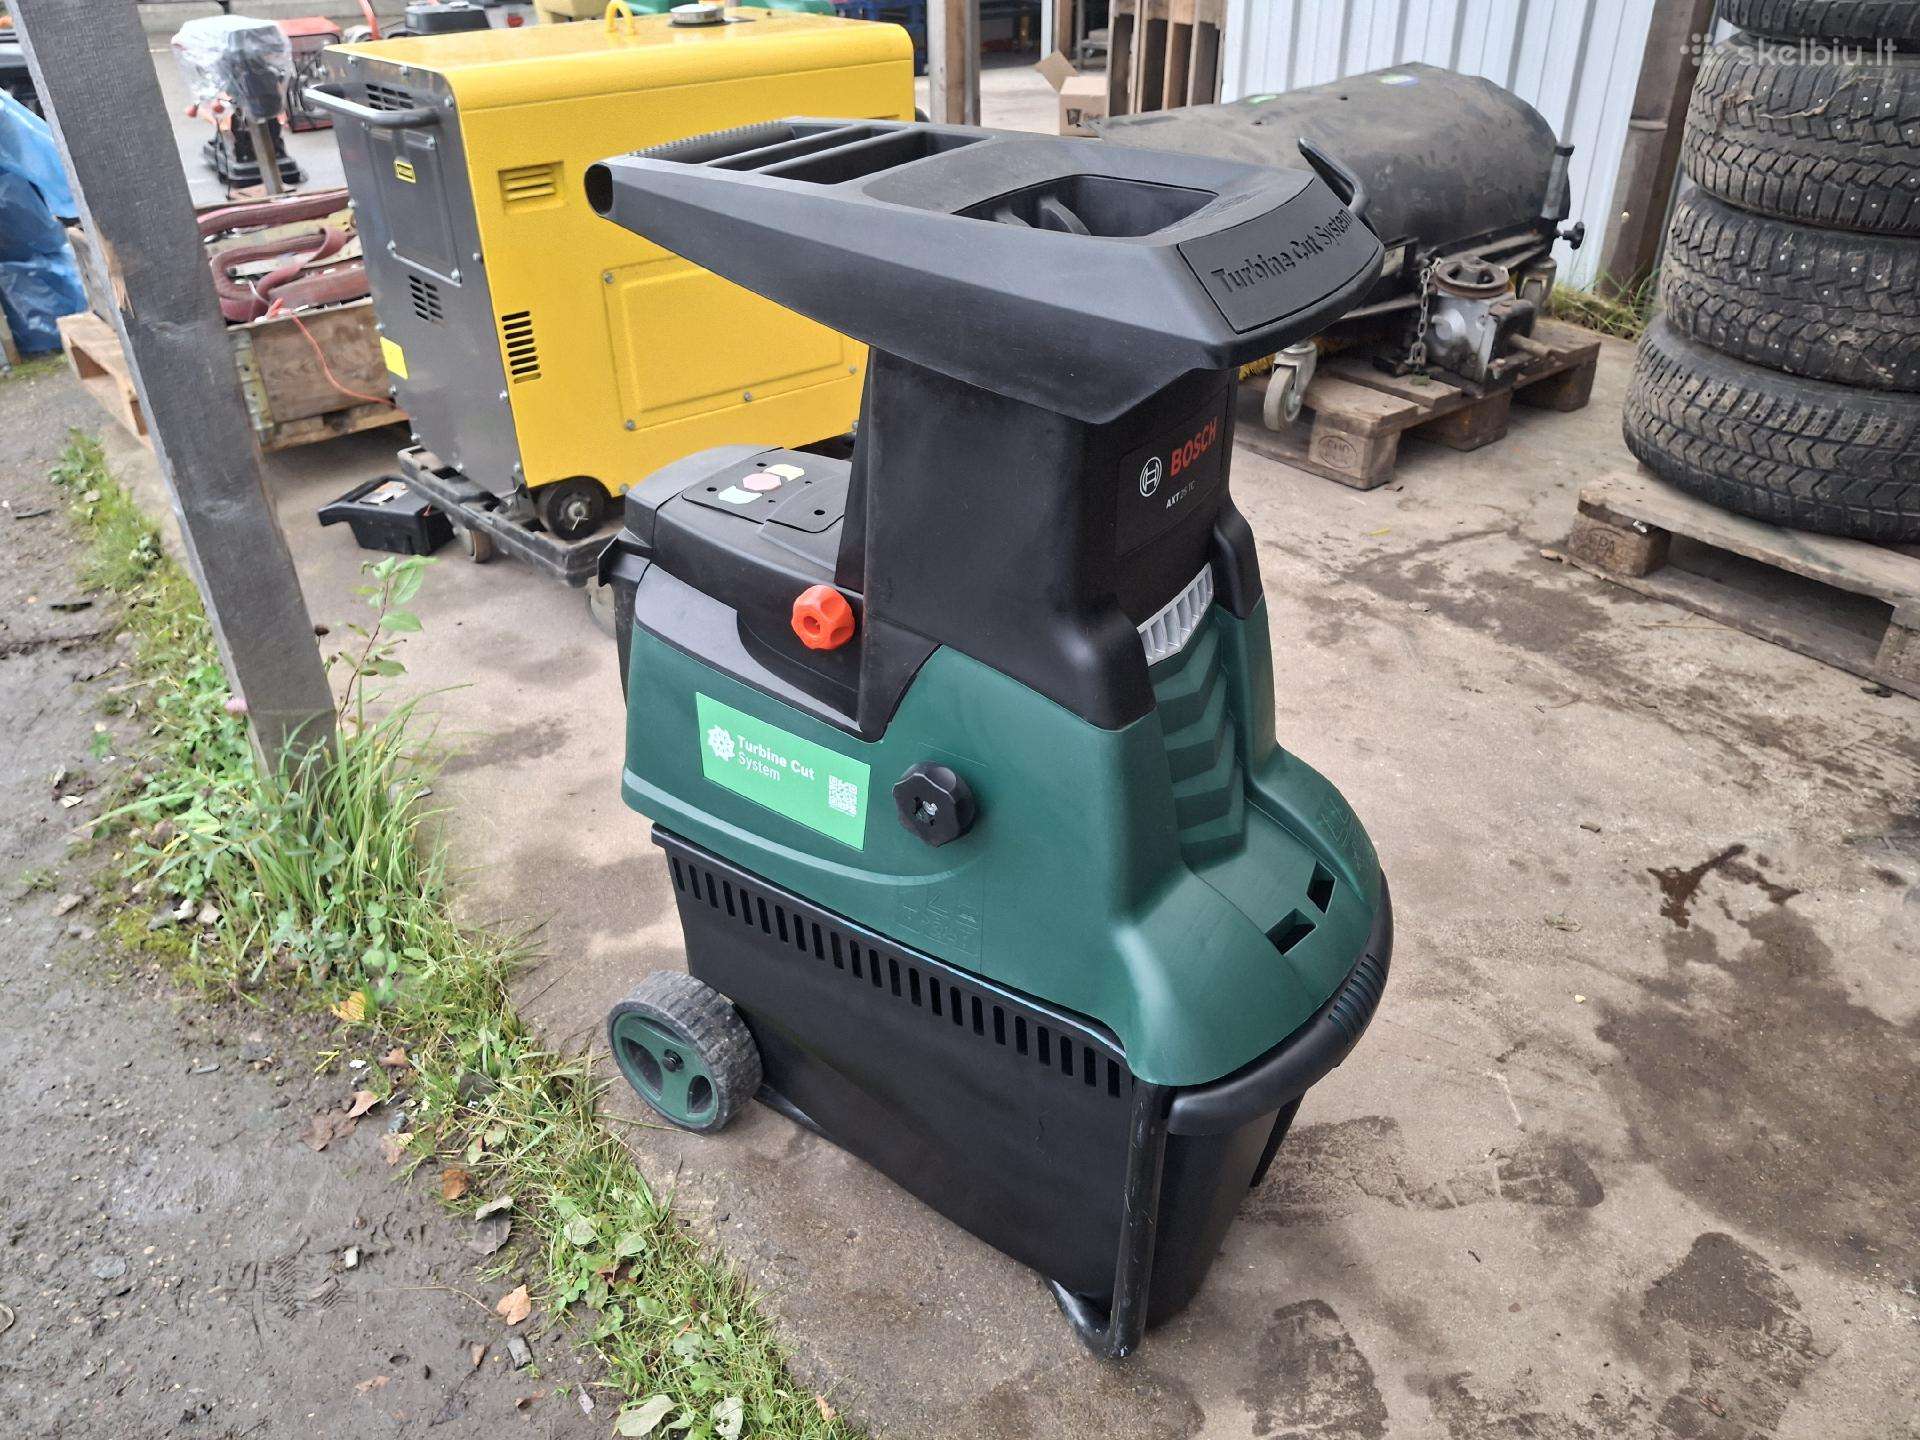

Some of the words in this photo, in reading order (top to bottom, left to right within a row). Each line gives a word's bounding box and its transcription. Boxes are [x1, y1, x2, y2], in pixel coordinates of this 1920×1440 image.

[1211, 252, 1297, 293] Turbine
[1290, 234, 1324, 261] Cut
[1315, 208, 1351, 247] System
[1170, 415, 1219, 477] BOSCH
[1165, 492, 1181, 510] AXT
[737, 734, 788, 768] Turbine
[790, 759, 816, 781] Cut
[738, 751, 781, 782] System
